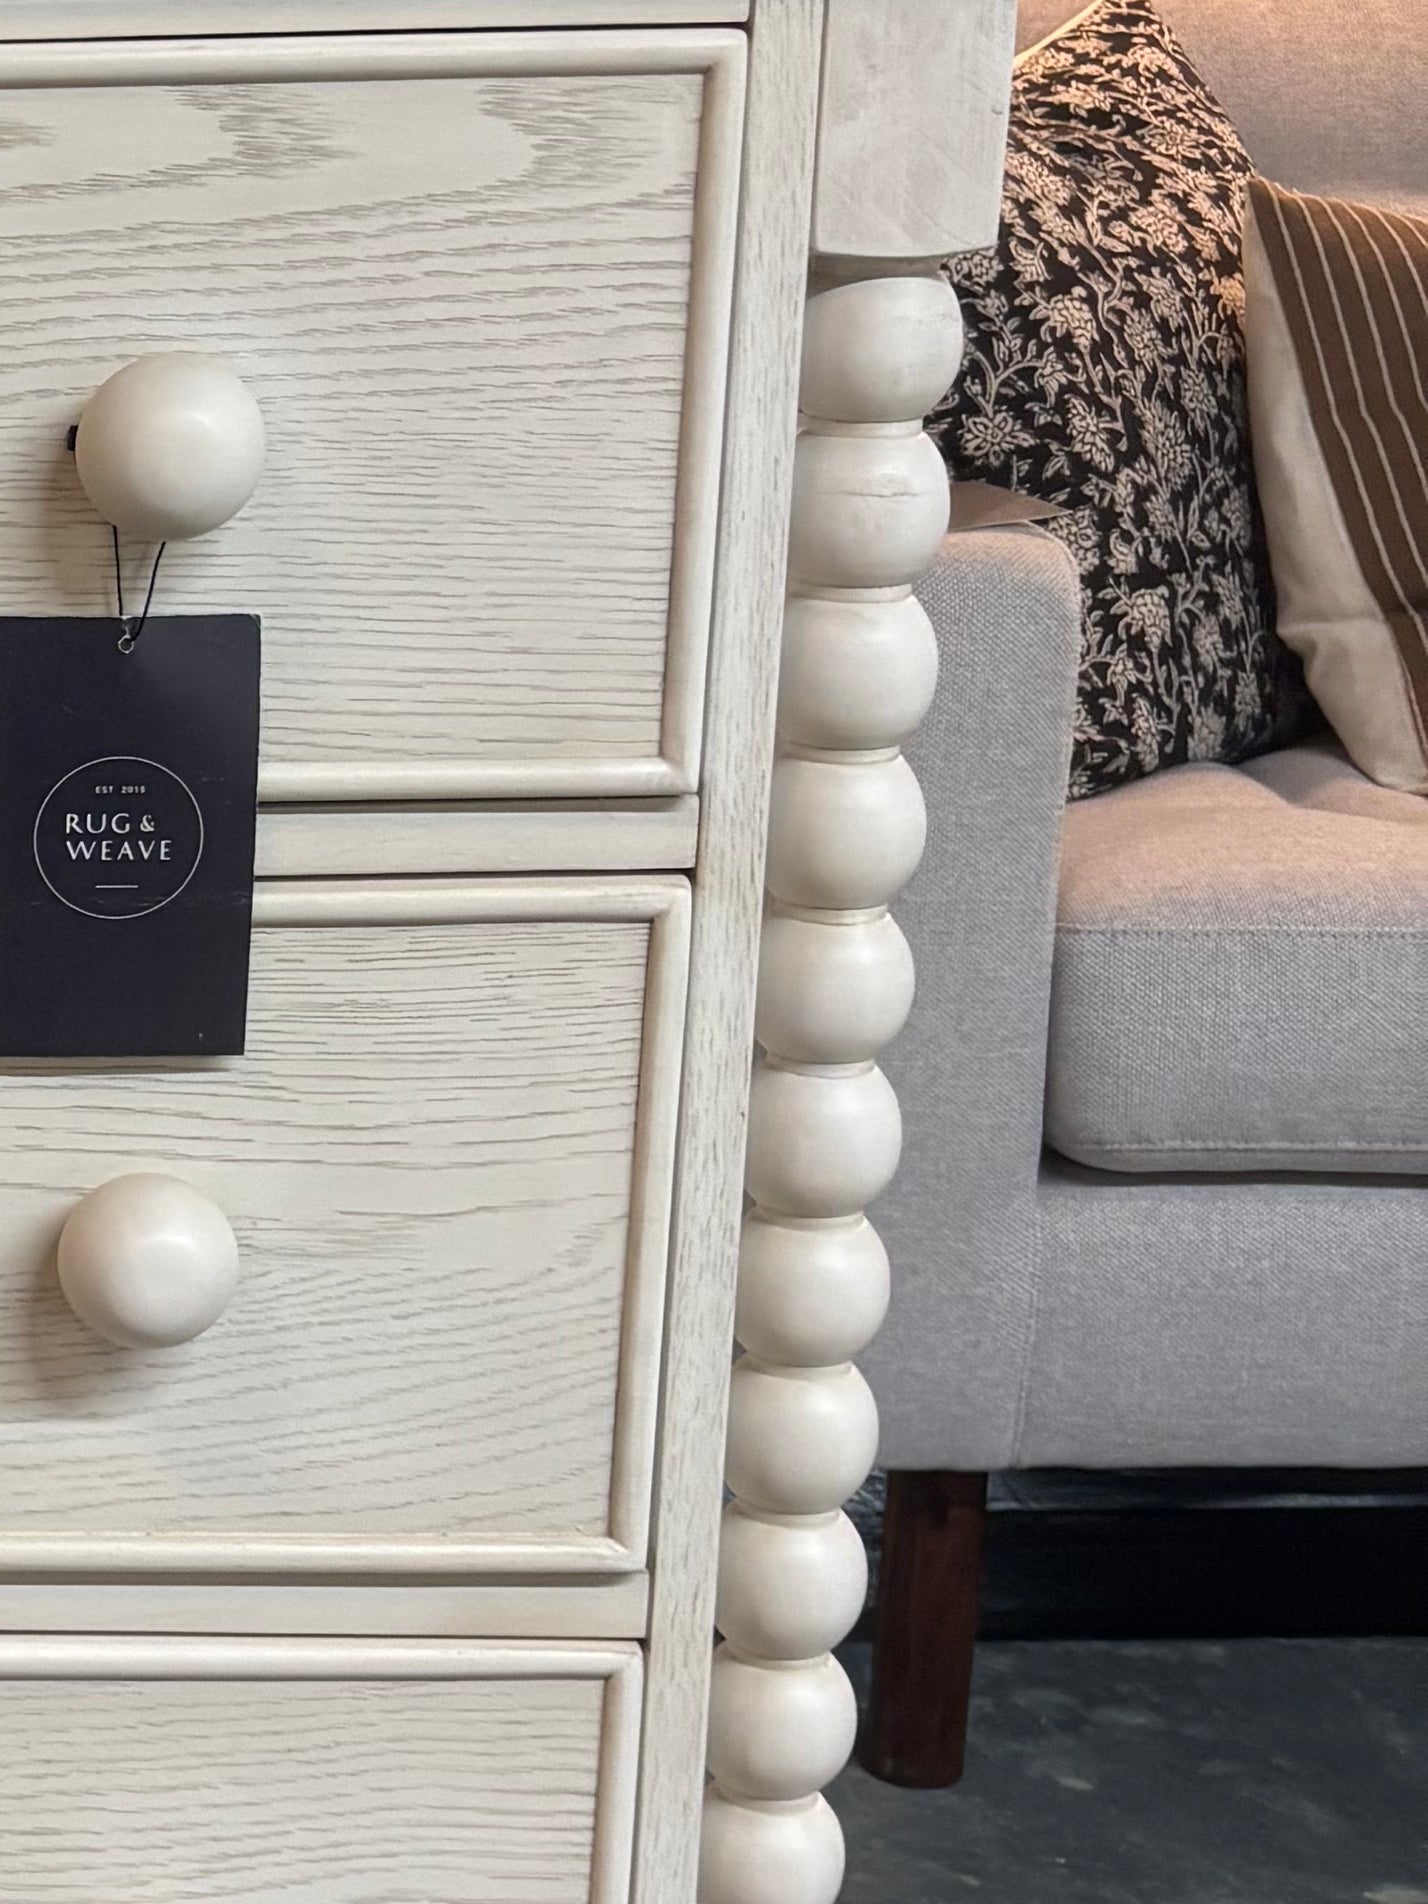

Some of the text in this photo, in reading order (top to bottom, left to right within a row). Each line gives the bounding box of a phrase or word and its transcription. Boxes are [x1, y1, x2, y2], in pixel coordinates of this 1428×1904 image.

[95, 785, 113, 794] EST
[65, 813, 155, 834] RUG &
[66, 840, 172, 861] WEAVE
